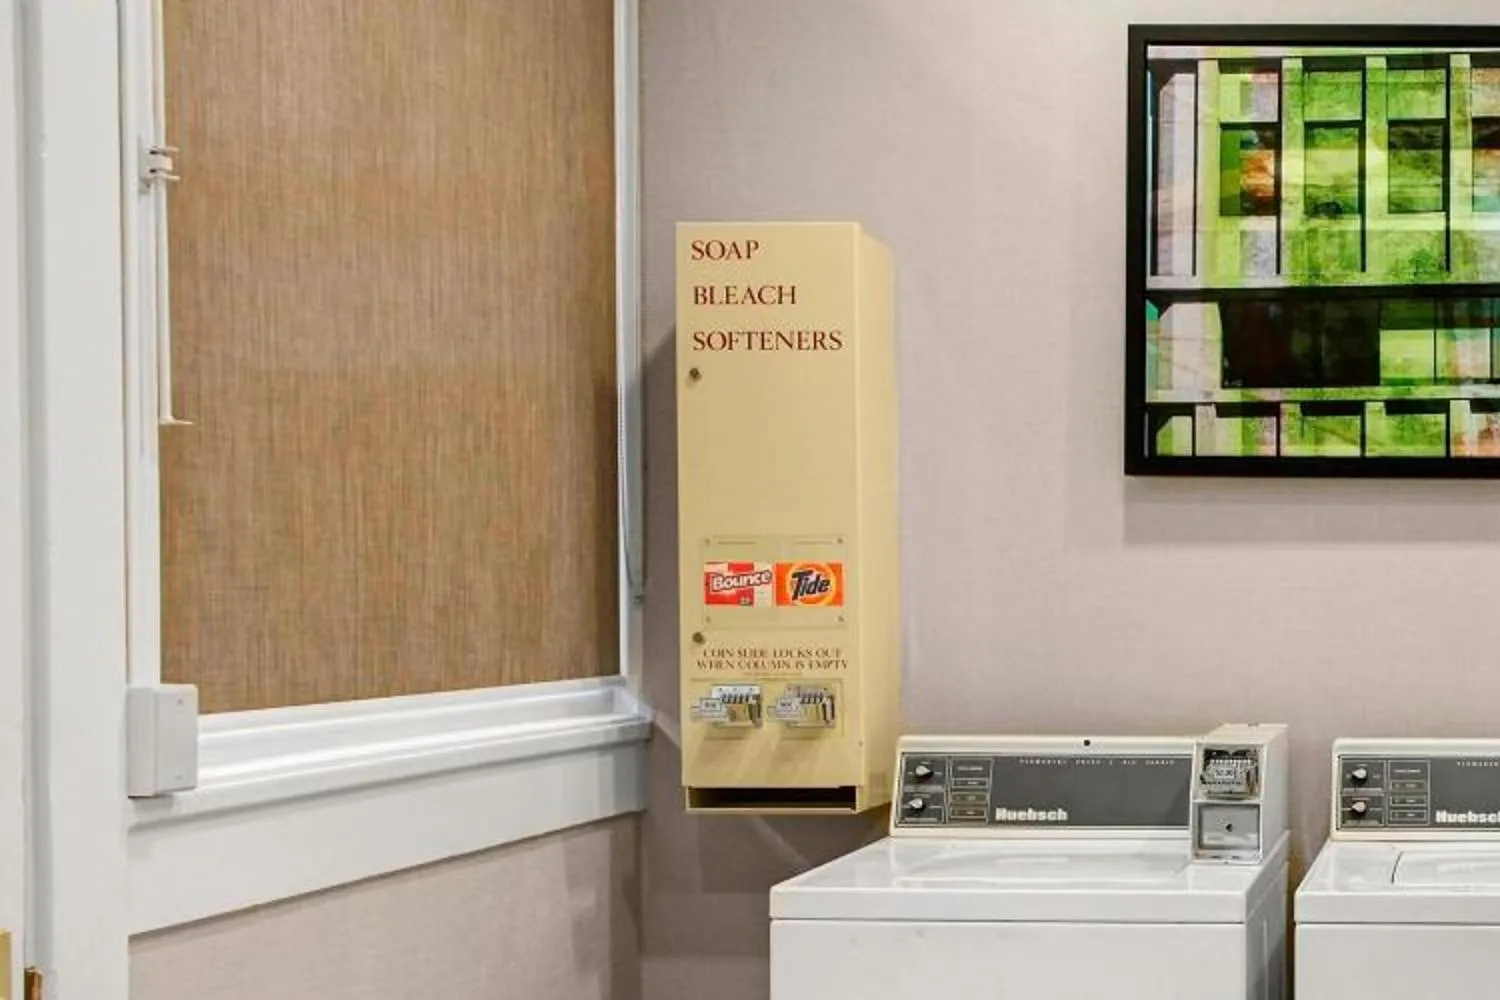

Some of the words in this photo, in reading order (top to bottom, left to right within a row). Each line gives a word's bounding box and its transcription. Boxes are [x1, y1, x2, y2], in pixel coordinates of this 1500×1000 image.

[690, 239, 760, 261] SOAP
[692, 285, 797, 306] BLEACH
[692, 330, 844, 351] SOFTENERS
[711, 569, 772, 593] Bounce
[791, 570, 831, 601] Tide
[703, 648, 734, 659] COIN
[815, 648, 842, 659] OUT
[697, 659, 735, 670] WHEN
[737, 659, 792, 670] COLUMN
[795, 659, 805, 670] IS
[808, 659, 849, 670] EMPTY
